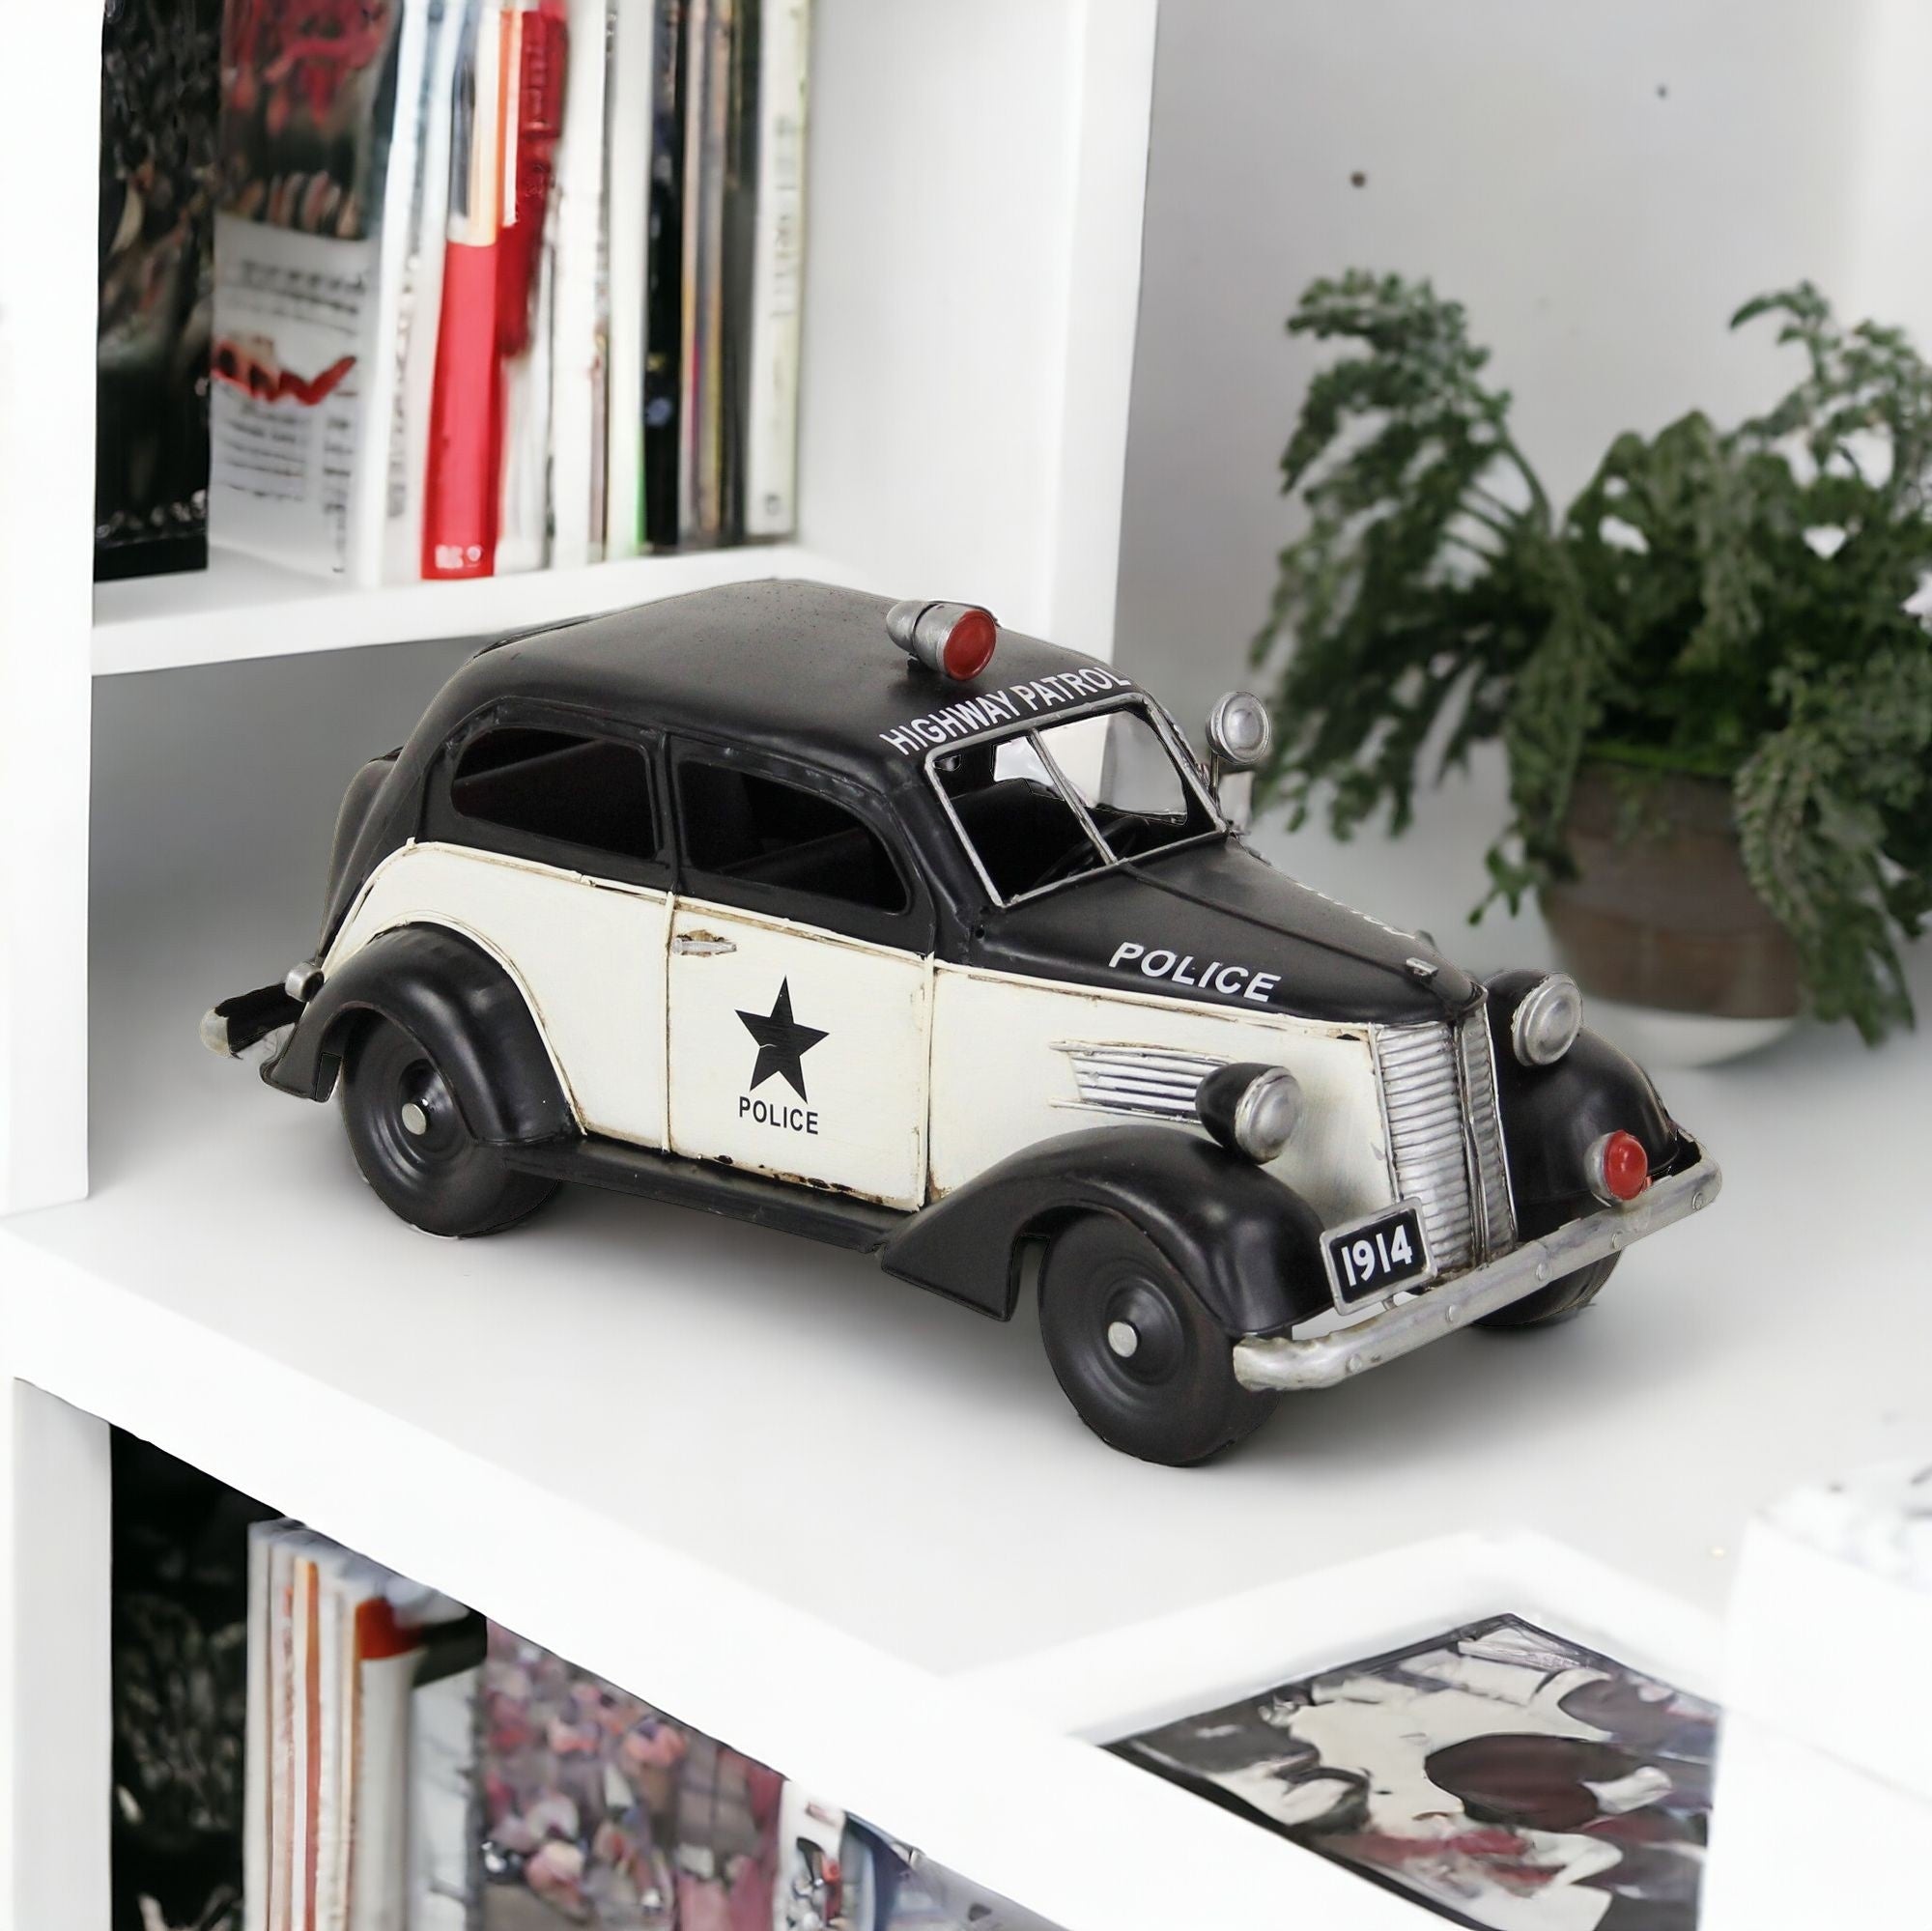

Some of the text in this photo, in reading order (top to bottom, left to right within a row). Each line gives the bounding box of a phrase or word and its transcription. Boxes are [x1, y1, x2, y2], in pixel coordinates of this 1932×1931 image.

[879, 667, 1131, 755] HIGHWAY PATROL
[1108, 941, 1281, 1003] POLICE
[739, 1095, 818, 1135] POLICE
[1341, 1224, 1412, 1287] 1914
